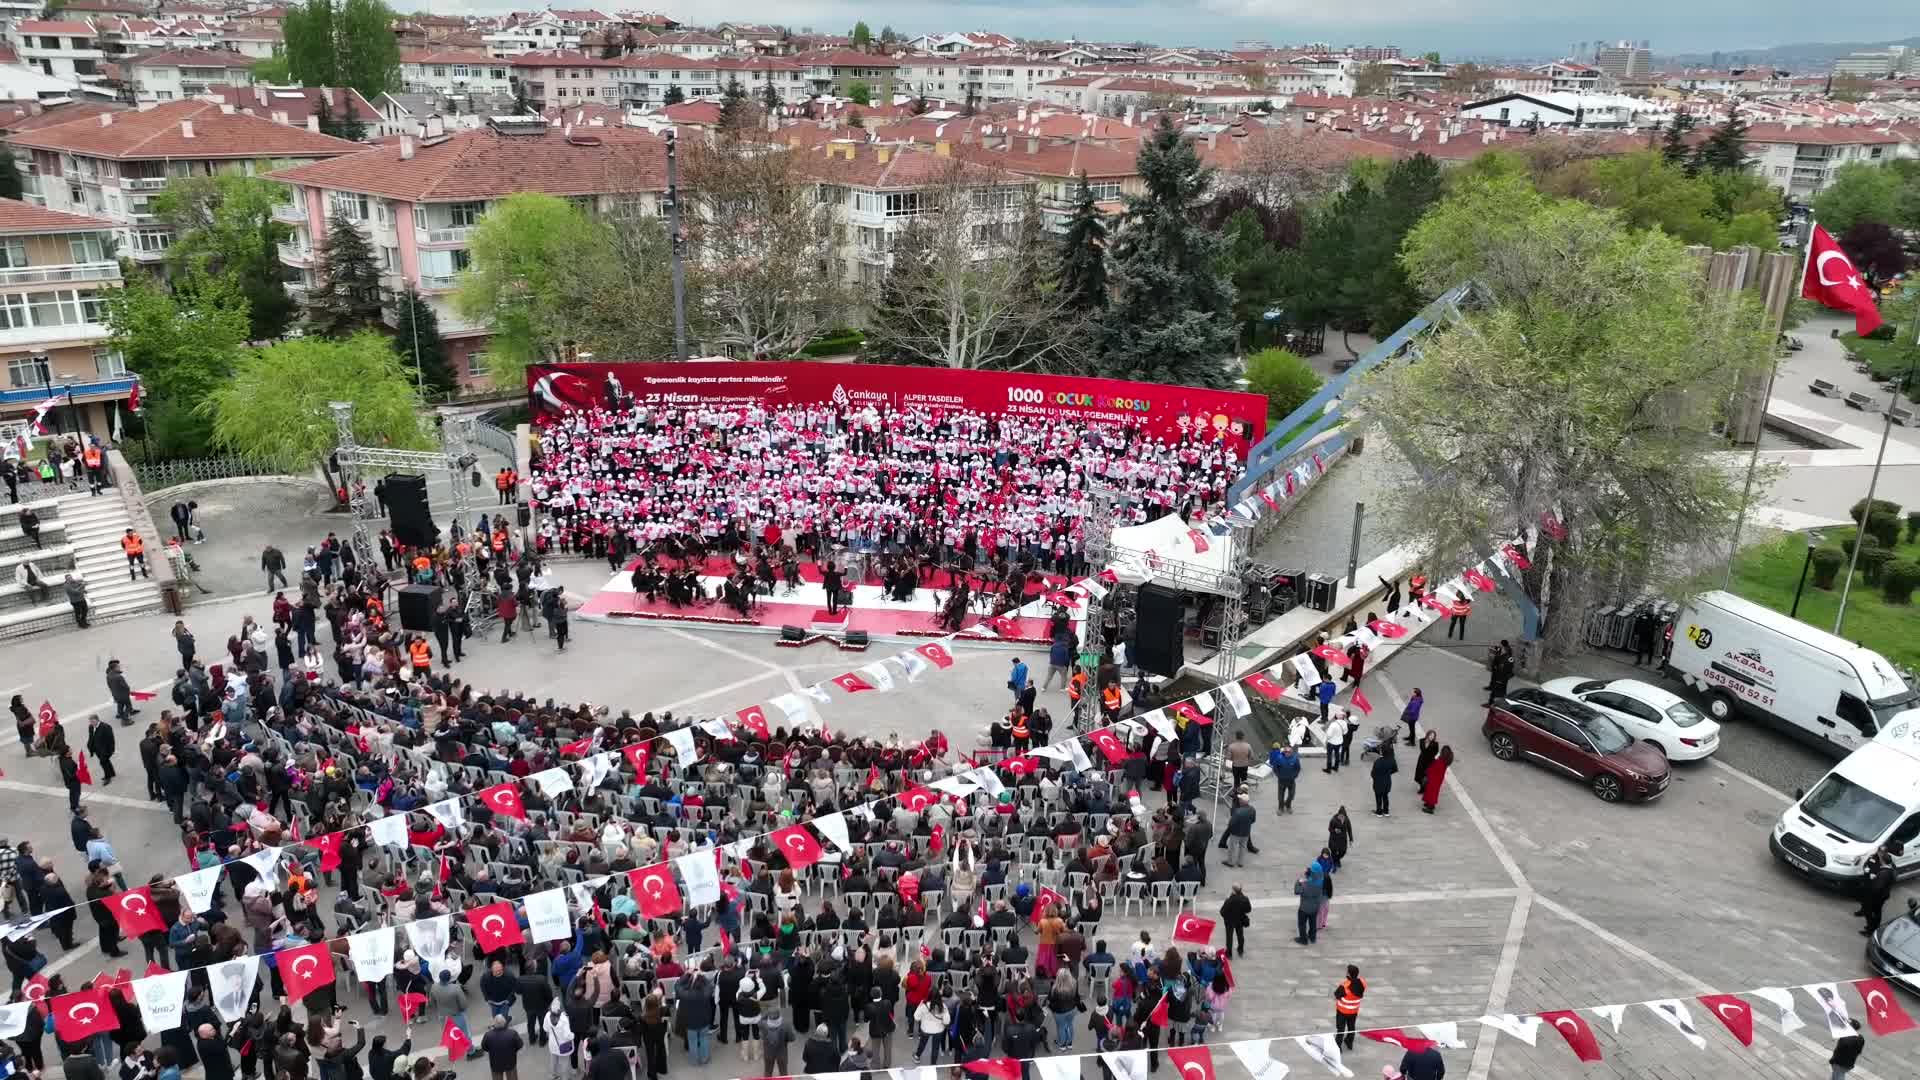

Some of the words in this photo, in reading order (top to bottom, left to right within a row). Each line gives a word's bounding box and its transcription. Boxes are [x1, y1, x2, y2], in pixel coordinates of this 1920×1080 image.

[645, 393, 661, 403] 23
[663, 392, 699, 403] Nisan
[904, 394, 926, 402] ALPER
[1007, 387, 1044, 403] 1000
[1007, 404, 1018, 413] 23
[1019, 405, 1047, 415] NİSAN
[1135, 415, 1149, 425] VE
[1699, 631, 1711, 644] 24
[1703, 668, 1727, 685] 0543
[1728, 680, 1746, 694] 540
[1747, 688, 1761, 700] 52
